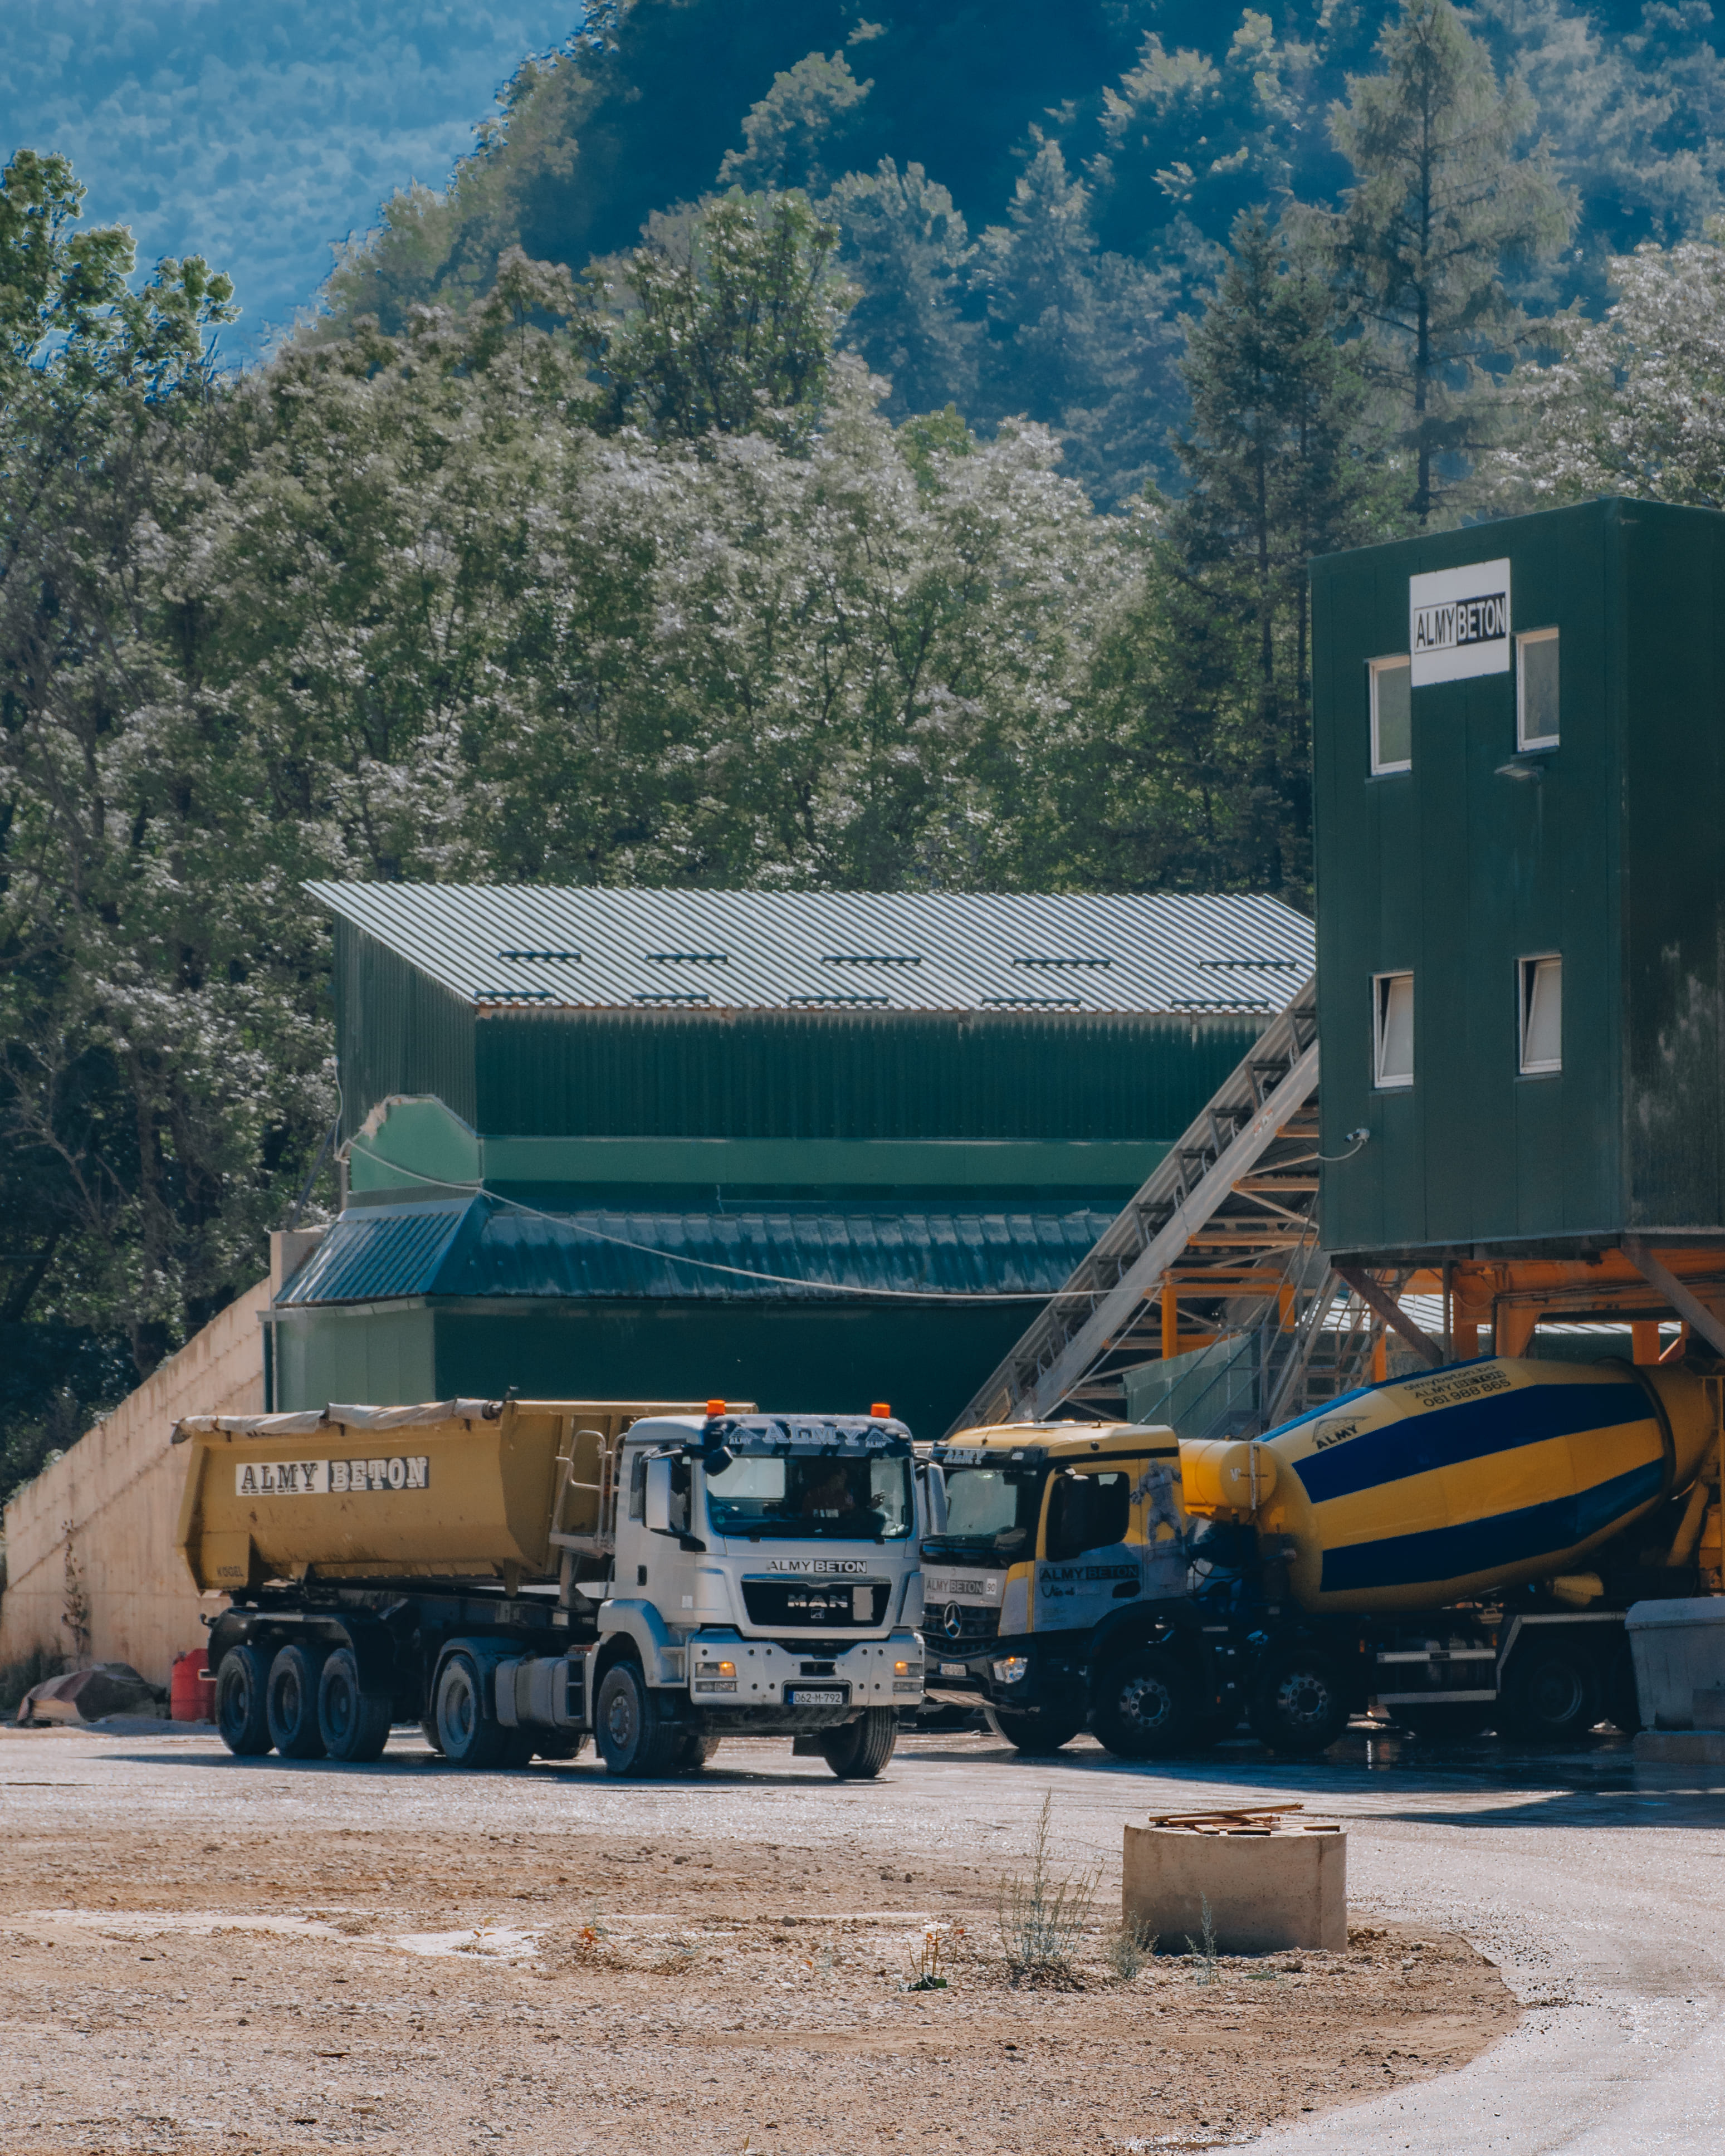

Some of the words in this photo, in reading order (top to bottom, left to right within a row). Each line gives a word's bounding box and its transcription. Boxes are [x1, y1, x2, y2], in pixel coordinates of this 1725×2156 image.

[1416, 607, 1455, 648] ALMY
[1457, 598, 1506, 642] BETON
[1415, 1384, 1451, 1399] ALMY
[1423, 1394, 1450, 1407] 061
[1450, 1386, 1480, 1400] 988
[1481, 1379, 1511, 1392] 865
[762, 1424, 859, 1446] ALMY
[1316, 1424, 1358, 1450] ALMY
[241, 1463, 318, 1494] ALMY
[330, 1456, 428, 1492] BETON
[770, 1561, 810, 1571] ALMY
[815, 1561, 867, 1573] BETON
[1042, 1567, 1084, 1580] ALMY
[1087, 1566, 1137, 1580] BETON
[926, 1580, 948, 1591] ALMY
[950, 1580, 983, 1593] BETON
[788, 1594, 848, 1607] MAN
[794, 1693, 840, 1703] 062-M-792
